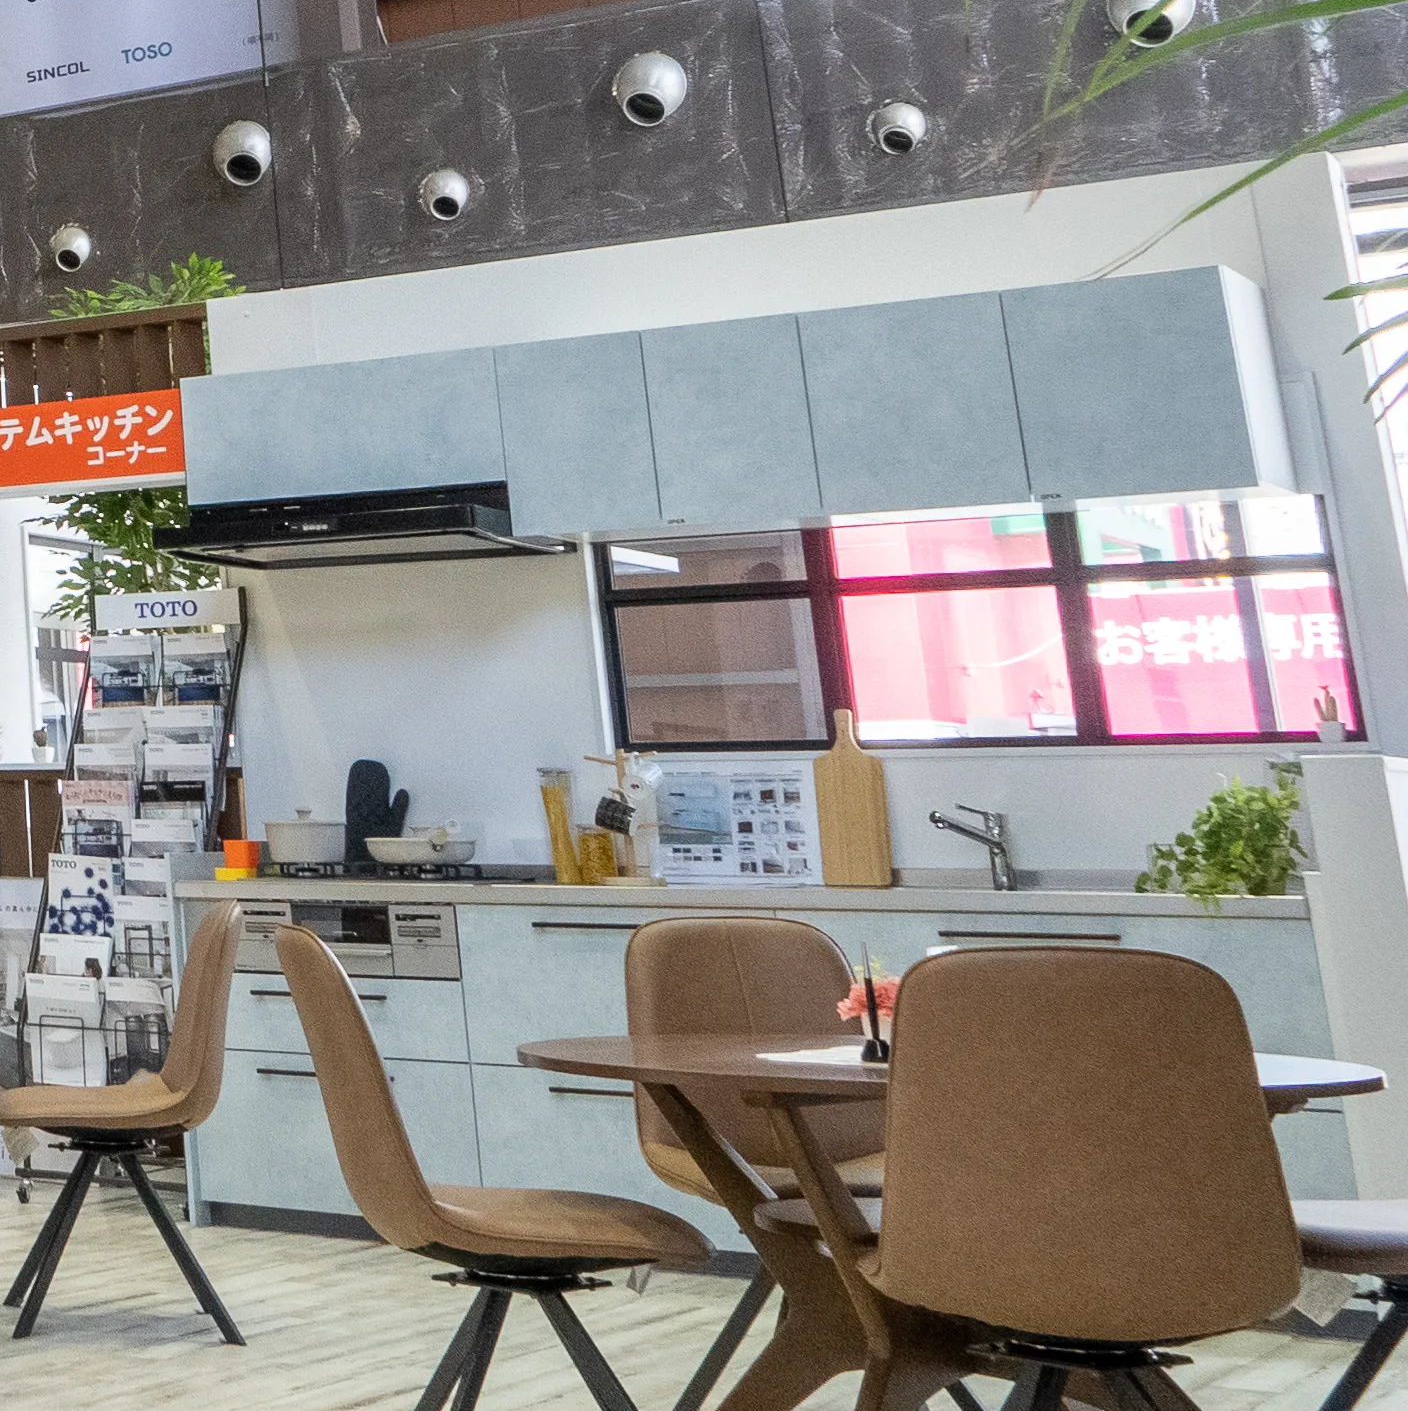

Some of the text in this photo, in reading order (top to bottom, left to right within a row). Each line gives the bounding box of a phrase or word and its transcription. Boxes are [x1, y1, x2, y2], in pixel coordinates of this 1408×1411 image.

[121, 42, 173, 64] TOSO
[26, 61, 90, 84] SINCOL
[87, 440, 167, 467] コーナー
[134, 600, 198, 619] TOTO
[51, 859, 77, 870] TOTO
